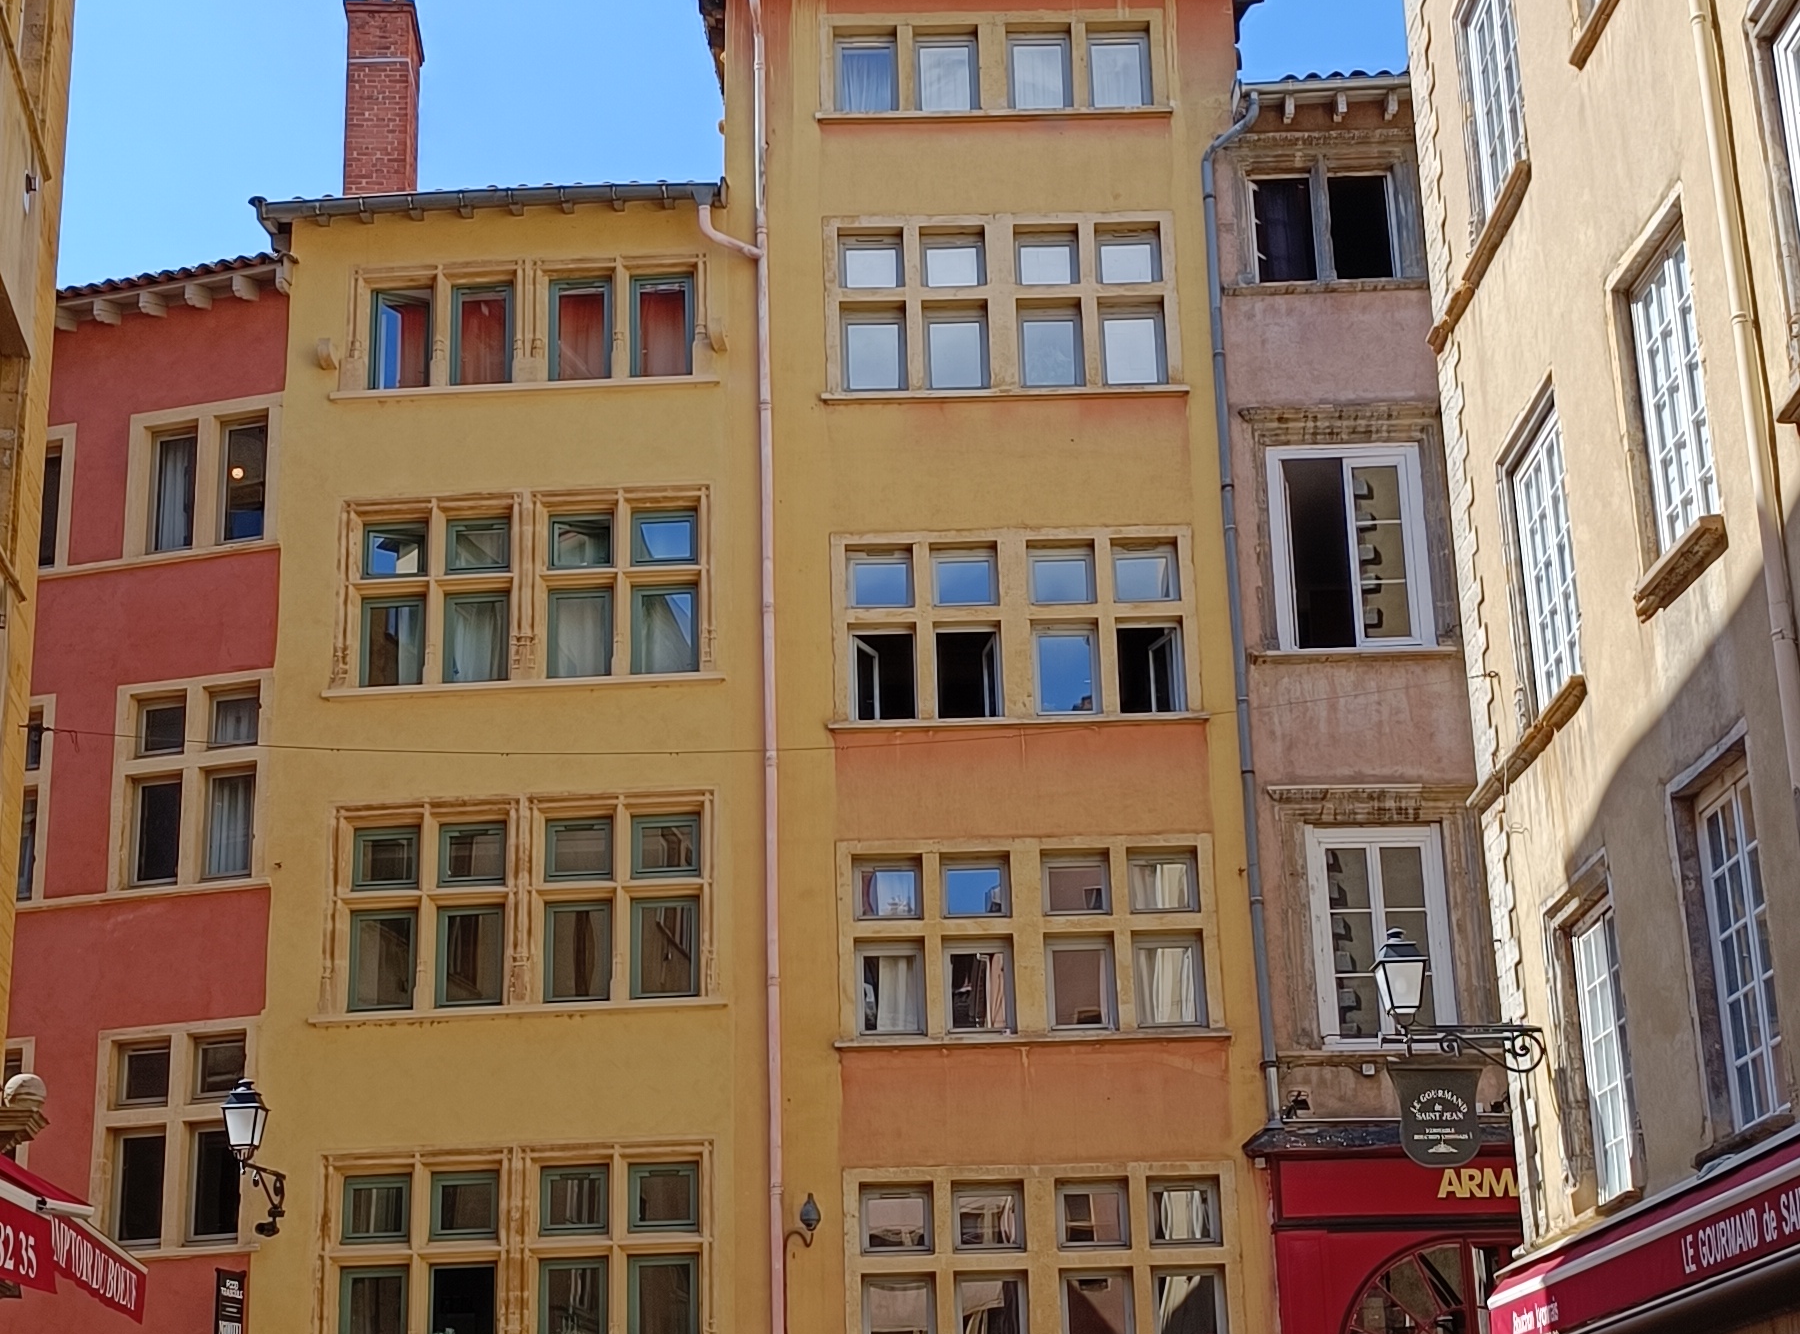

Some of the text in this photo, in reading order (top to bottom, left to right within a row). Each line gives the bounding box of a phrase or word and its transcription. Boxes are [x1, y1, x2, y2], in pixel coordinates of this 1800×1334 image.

[1415, 1111, 1464, 1121] SAINT JEAN
[1419, 1089, 1468, 1113] GOURMAND
[1437, 1167, 1520, 1198] ARM
[1681, 1187, 1800, 1274] LE GOURMAND de SAI
[19, 1231, 37, 1279] 35
[50, 1215, 94, 1286] MPTOIR
